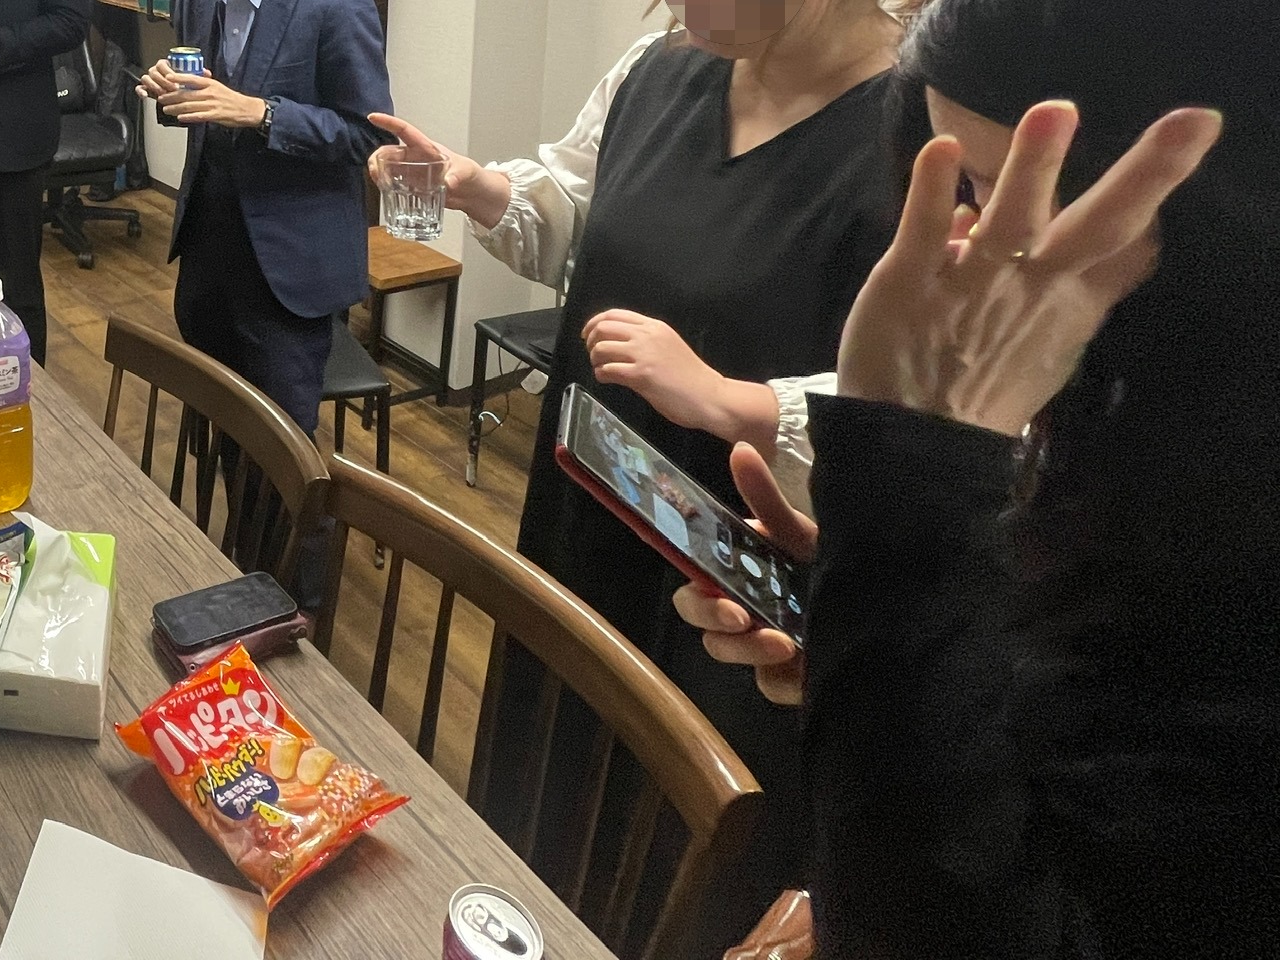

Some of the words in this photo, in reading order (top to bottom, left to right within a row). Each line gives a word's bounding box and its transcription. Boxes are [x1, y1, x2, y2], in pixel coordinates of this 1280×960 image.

[153, 689, 277, 776] ハッピーターン
